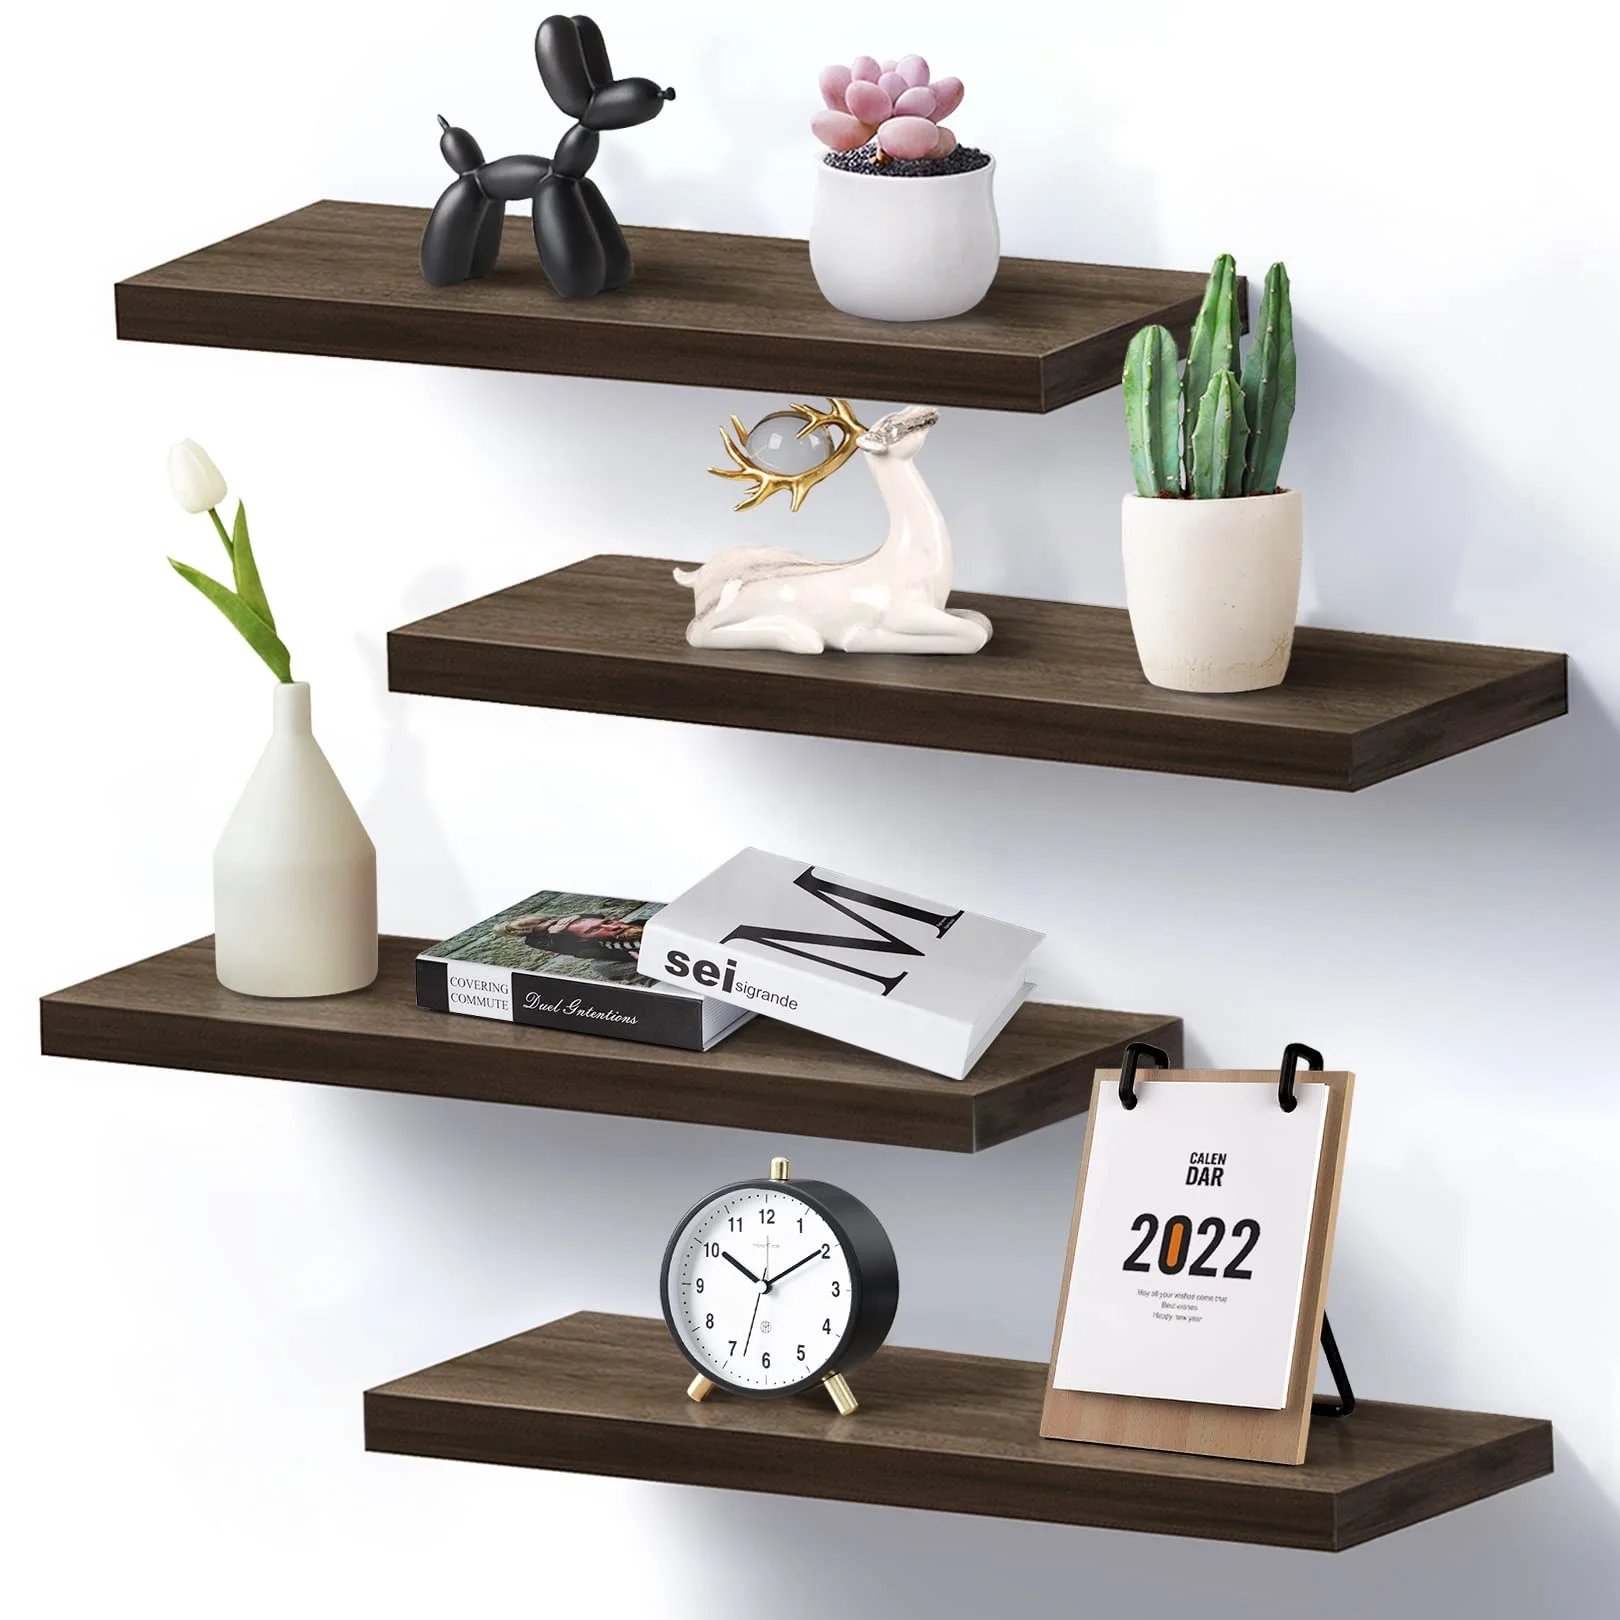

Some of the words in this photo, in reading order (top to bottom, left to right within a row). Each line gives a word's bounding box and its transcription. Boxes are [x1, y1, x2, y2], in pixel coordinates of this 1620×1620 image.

[719, 866, 965, 996] M
[450, 976, 509, 994] COVERING
[664, 950, 737, 993] sei
[735, 981, 798, 1010] sigrande
[450, 992, 509, 1010] COMMUTE
[523, 991, 563, 1013] Duel
[1189, 1152, 1227, 1165] CALEN
[1185, 1166, 1224, 1187] DAR
[728, 1217, 743, 1232] 11
[758, 1209, 775, 1224] 12
[796, 1218, 803, 1233] 1
[703, 1242, 720, 1258] 10
[821, 1244, 831, 1260] 2
[1122, 1213, 1261, 1280] 2022
[696, 1278, 704, 1293] 9
[831, 1281, 840, 1297] 3
[706, 1313, 714, 1329] 8
[822, 1318, 831, 1334] 4
[728, 1341, 737, 1356] 7
[796, 1345, 805, 1361] 5
[762, 1352, 770, 1368] 6
